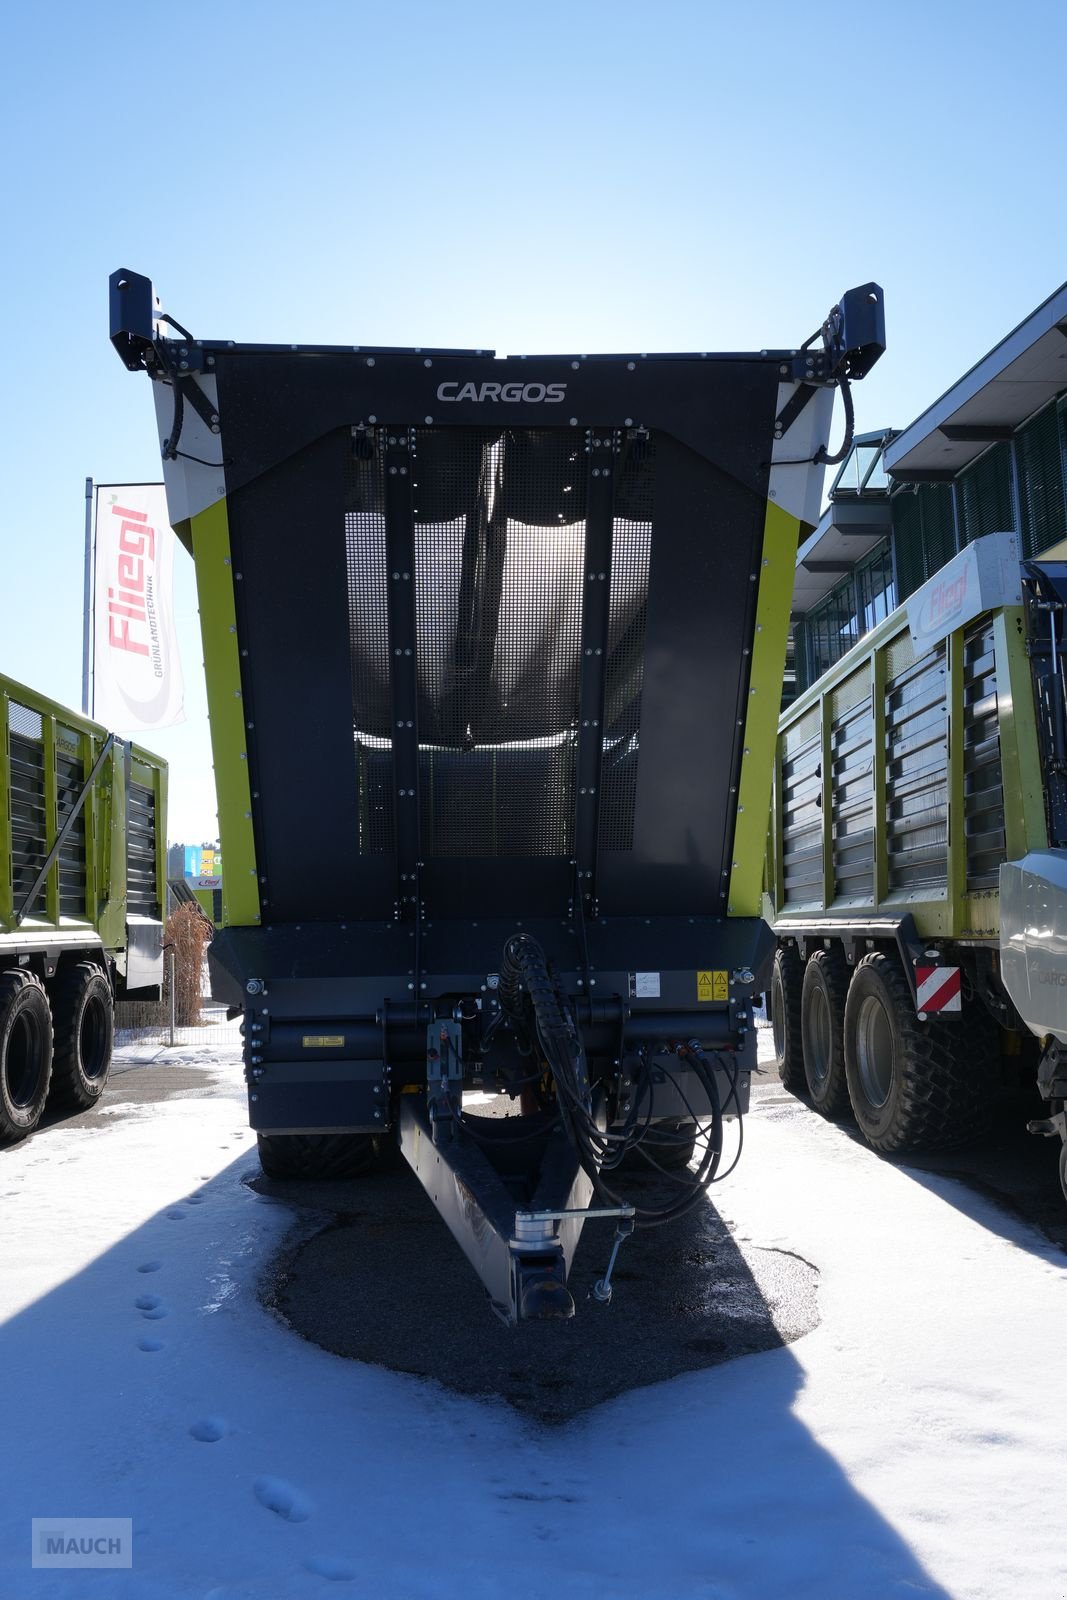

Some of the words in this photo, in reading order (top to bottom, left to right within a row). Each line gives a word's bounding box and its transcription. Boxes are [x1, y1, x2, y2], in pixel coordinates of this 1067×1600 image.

[437, 382, 567, 402] CARGOS
[108, 504, 155, 657] Fliegl
[146, 575, 163, 678] GRÜNLANDTECHNIK
